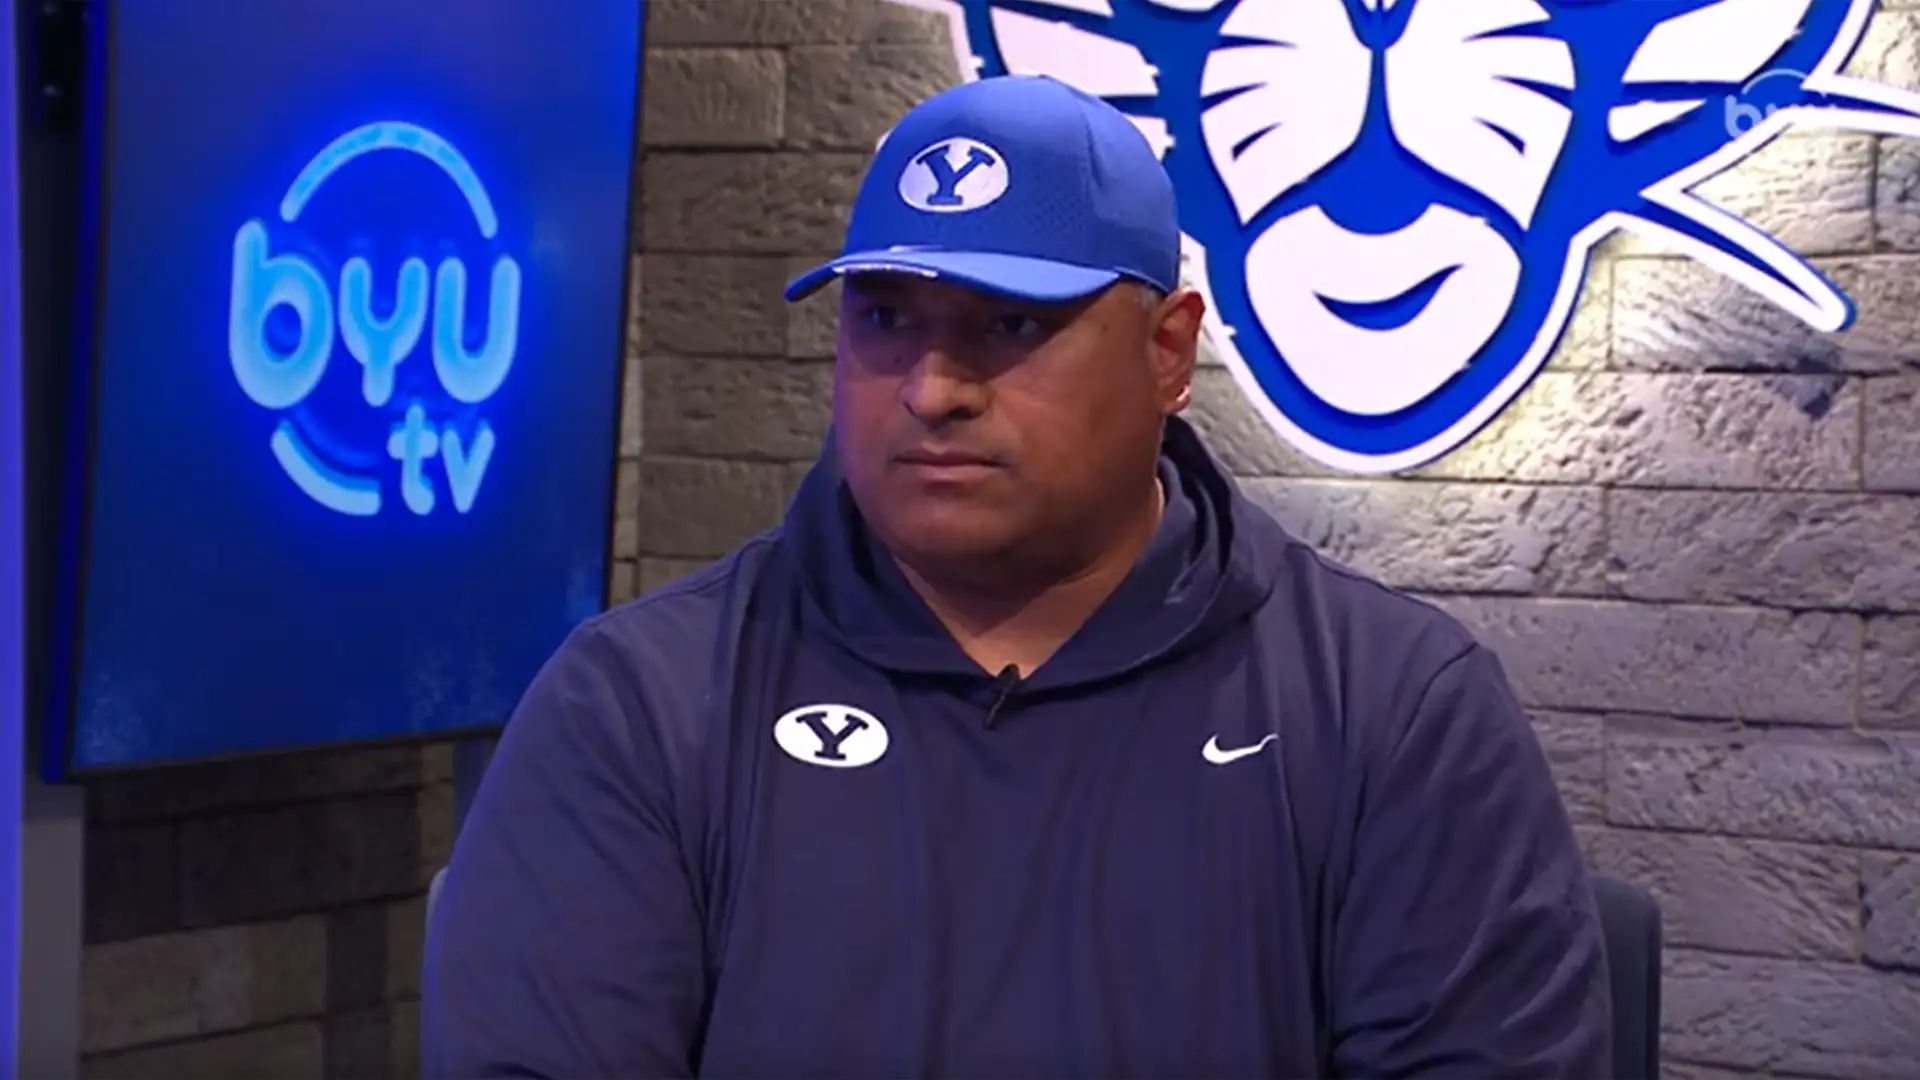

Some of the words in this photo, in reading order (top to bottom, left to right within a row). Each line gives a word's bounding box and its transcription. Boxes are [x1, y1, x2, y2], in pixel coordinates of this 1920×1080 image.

[915, 144, 996, 206] Y
[228, 218, 522, 410] byu
[387, 403, 496, 516] tv
[795, 710, 870, 761] Y
